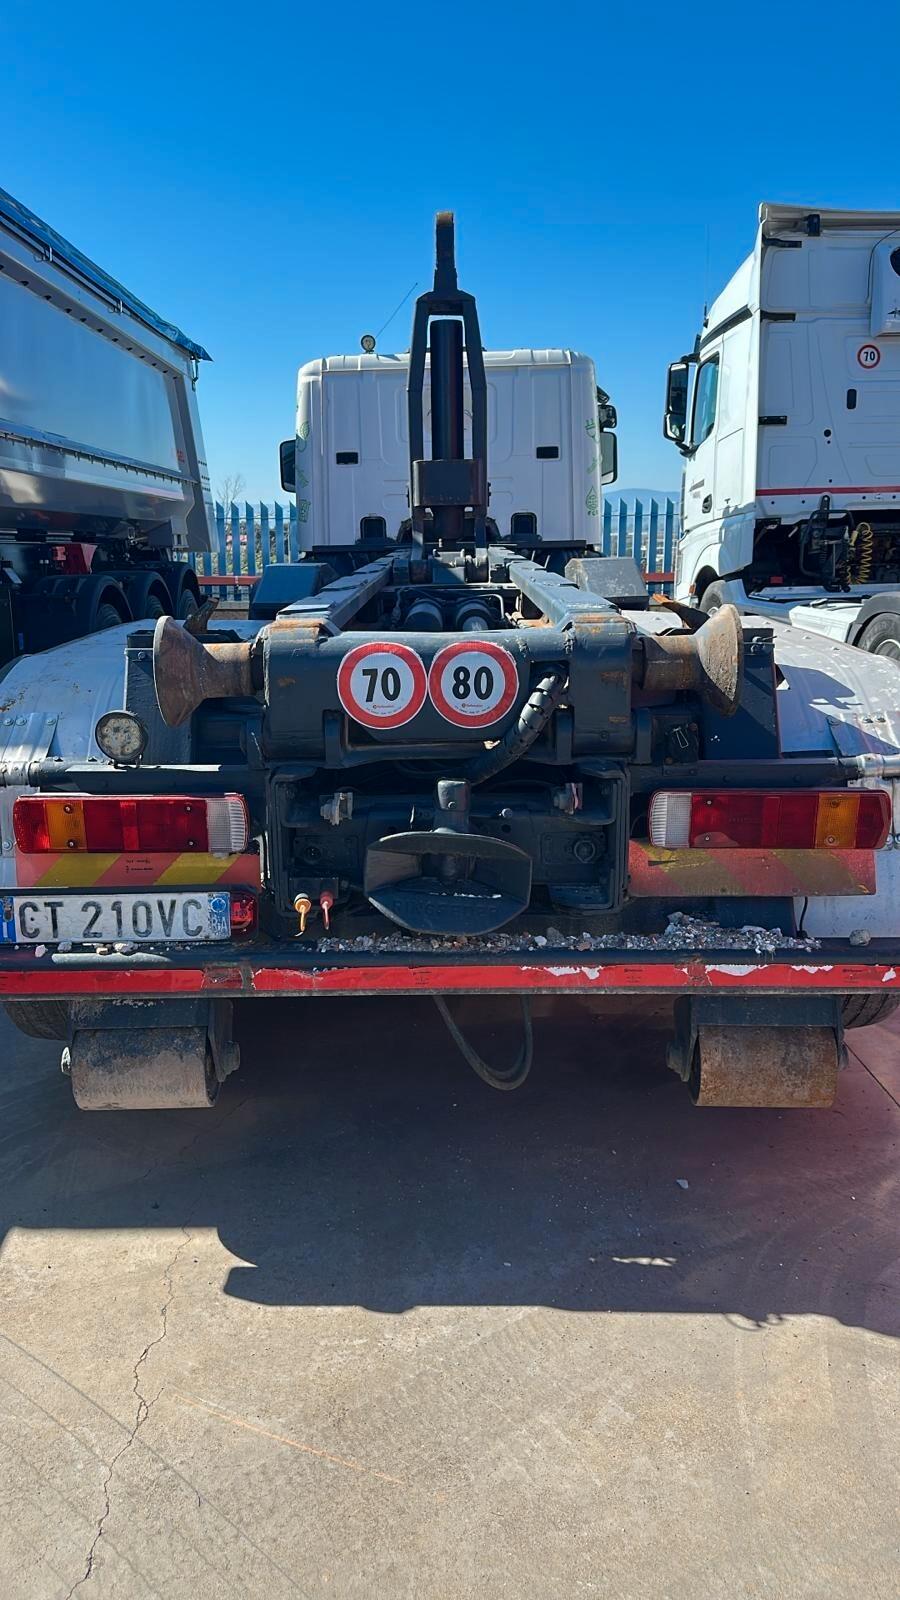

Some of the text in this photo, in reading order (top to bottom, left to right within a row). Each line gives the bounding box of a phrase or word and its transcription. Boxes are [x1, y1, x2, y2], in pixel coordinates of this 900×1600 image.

[864, 351, 875, 361] 70
[362, 667, 401, 702] 70
[452, 666, 494, 700] 80
[19, 899, 203, 938] CT 210VC
